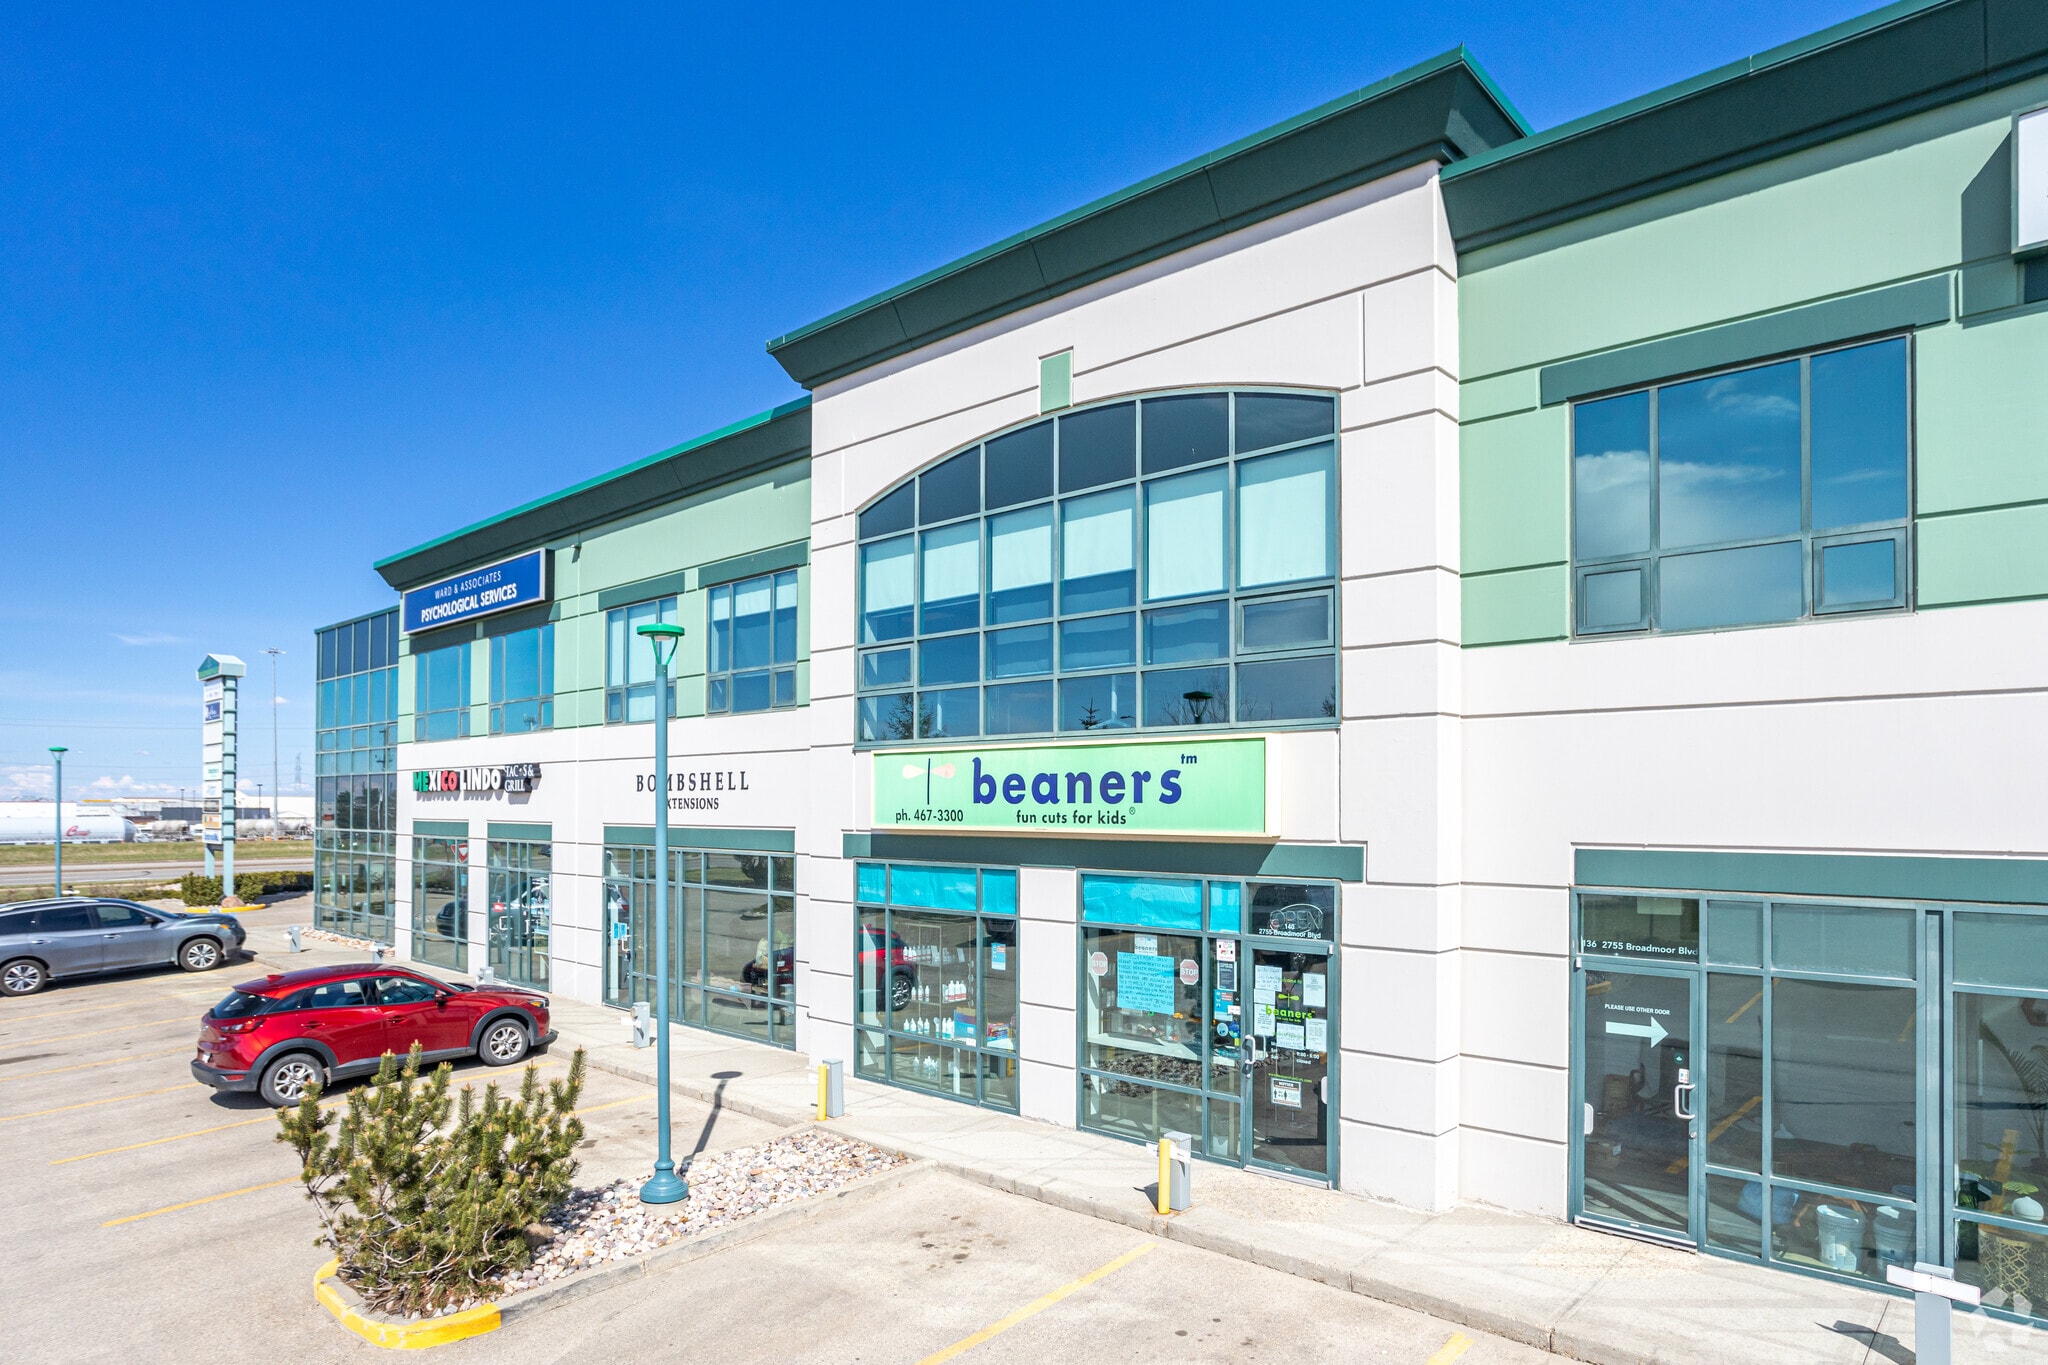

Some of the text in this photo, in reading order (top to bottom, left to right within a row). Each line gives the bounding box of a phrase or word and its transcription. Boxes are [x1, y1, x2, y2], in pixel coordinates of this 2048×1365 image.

[434, 571, 502, 599] WARD & ASSOCIATES
[421, 583, 518, 623] PSYCHOLOGICAL SERVICES
[412, 768, 502, 792] MEXICO LINDO
[505, 779, 526, 792] GRILL
[972, 757, 1182, 805] beaners
[666, 797, 719, 810] XTENSIONS
[895, 809, 964, 825] ph. 467-3300
[1016, 810, 1037, 823] fun
[1042, 812, 1067, 823] cuts
[1073, 810, 1092, 824] for
[1602, 940, 1624, 950] 2755
[1626, 943, 1676, 954] Broadmoor
[1678, 946, 1699, 956] Blvd
[1180, 967, 1199, 976] STOP
[1265, 1003, 1313, 1019] beaners
[1604, 1003, 1625, 1011] PLEASE
